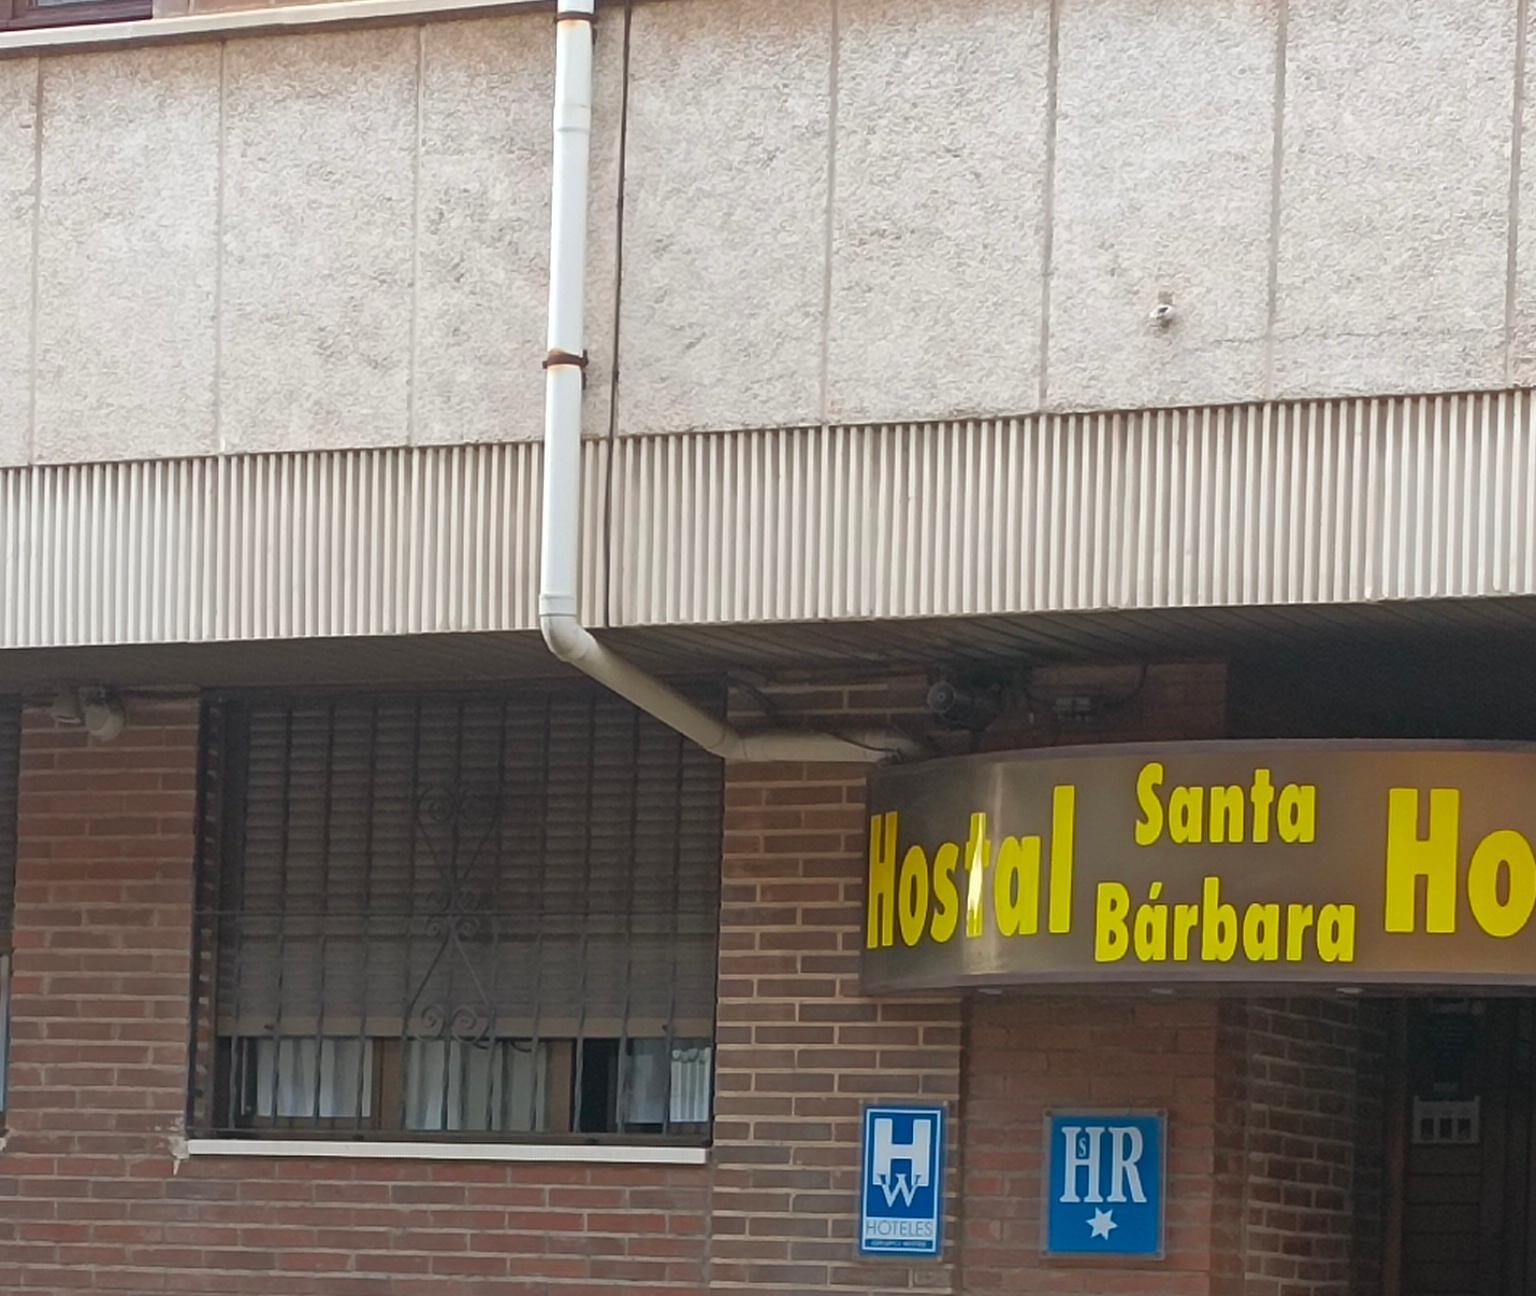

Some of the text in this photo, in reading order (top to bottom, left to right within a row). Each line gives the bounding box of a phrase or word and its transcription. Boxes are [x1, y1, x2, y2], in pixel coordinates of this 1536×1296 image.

[1134, 761, 1317, 846] Santa
[866, 783, 1076, 949] Hostal
[1093, 876, 1356, 963] Bárbara
[866, 1220, 934, 1237] HOTELES
